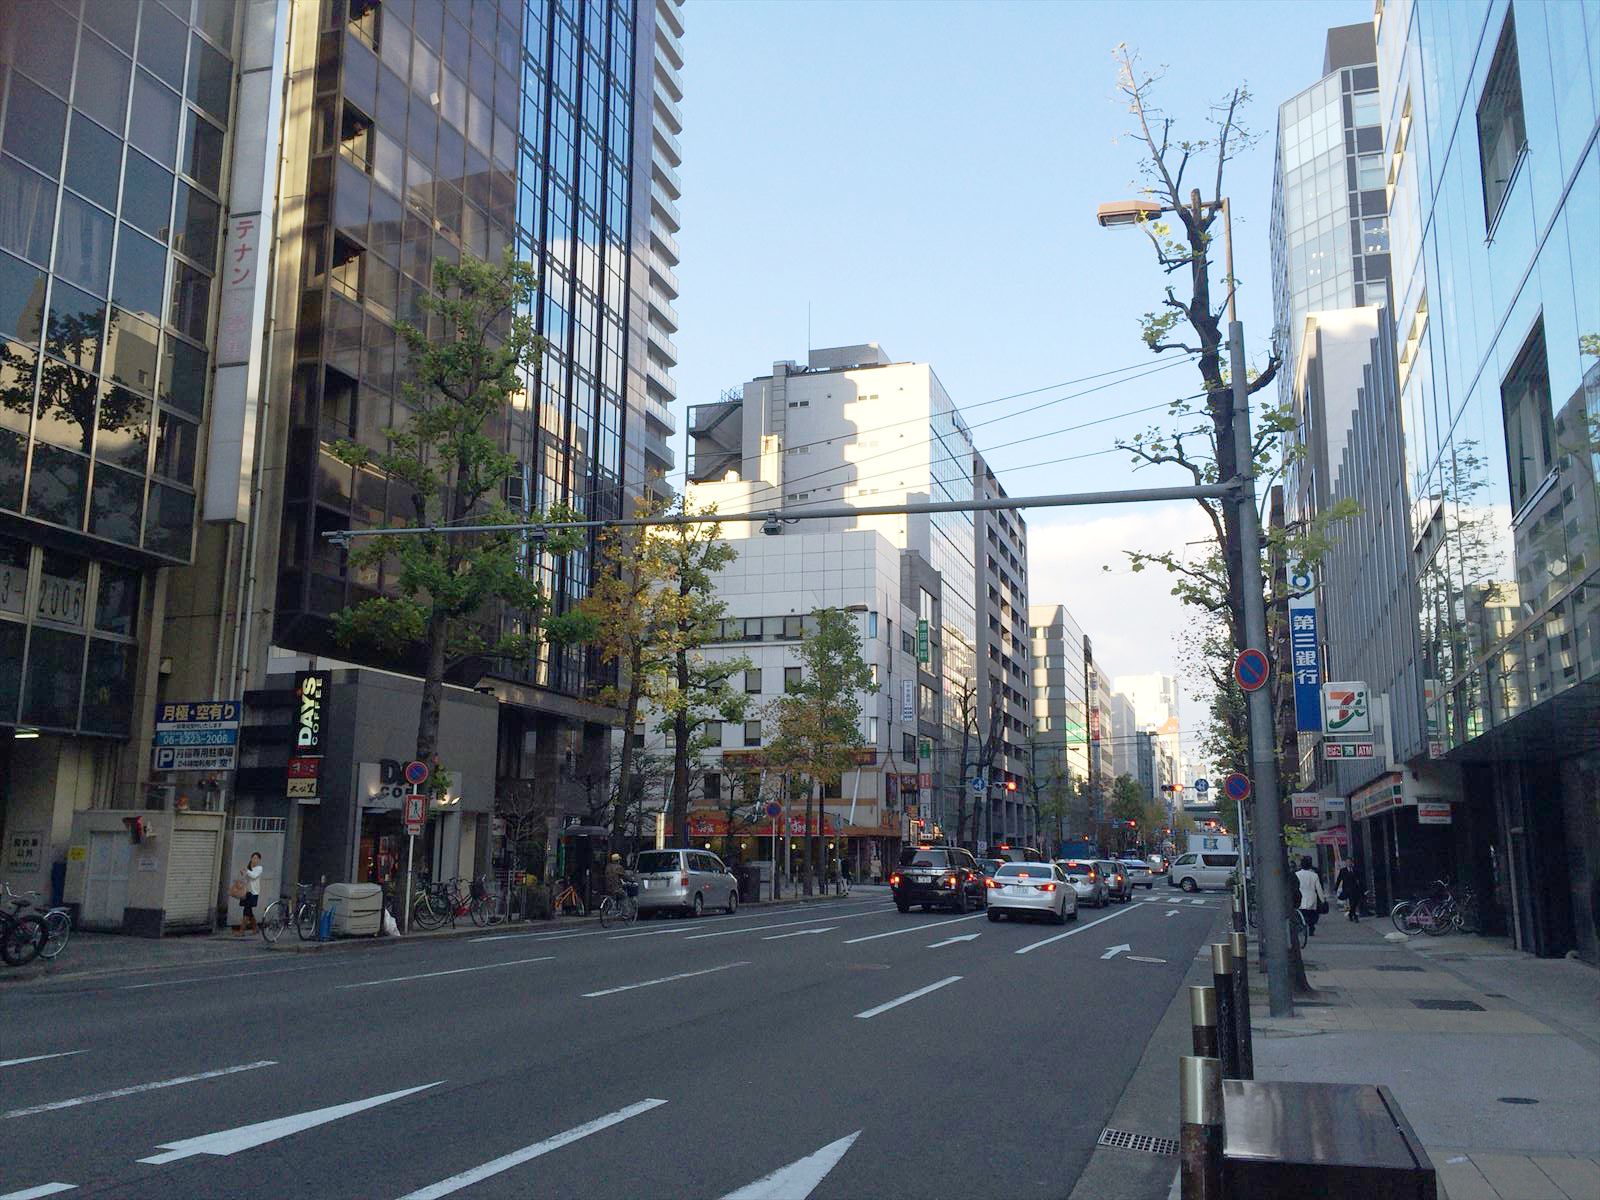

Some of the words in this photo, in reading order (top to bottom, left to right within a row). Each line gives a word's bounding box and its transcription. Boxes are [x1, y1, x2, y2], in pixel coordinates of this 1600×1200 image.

[1294, 614, 1318, 685] 第三銀行
[311, 678, 323, 746] COFFEE
[1358, 745, 1373, 756] ATM
